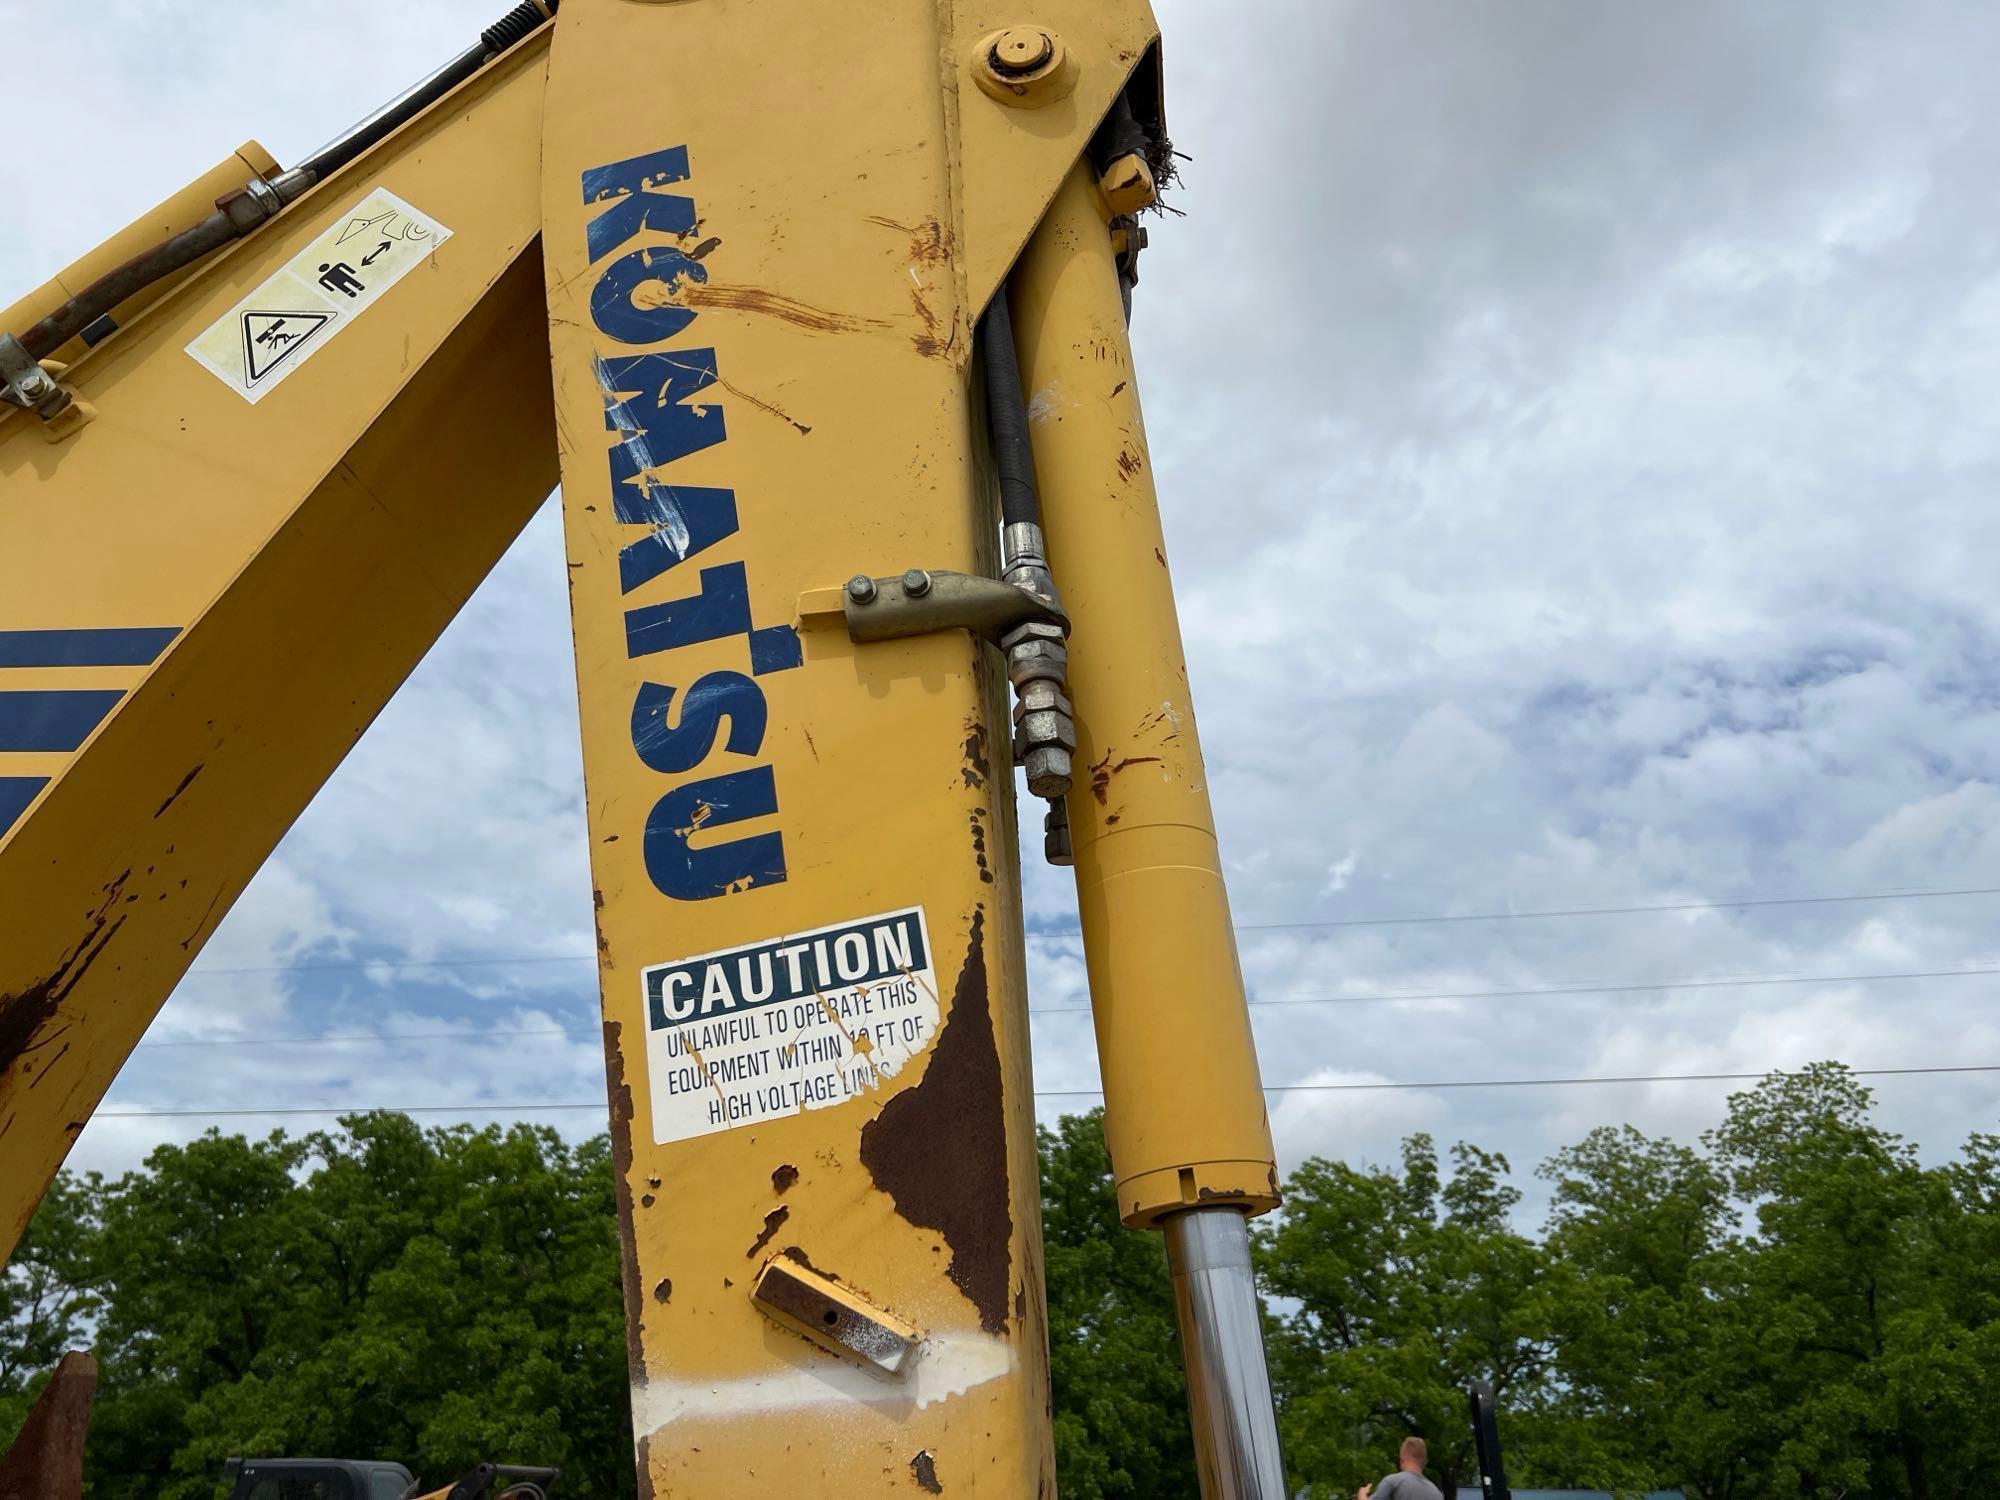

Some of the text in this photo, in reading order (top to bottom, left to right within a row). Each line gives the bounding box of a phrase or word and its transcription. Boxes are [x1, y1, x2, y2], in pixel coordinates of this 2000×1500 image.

[581, 144, 803, 901] KOMATSU
[662, 921, 913, 1020] CAUTION
[667, 981, 918, 1058] UNLAWFUL TO OPERATE THIS
[668, 1050, 770, 1095] EQUIPMENT
[776, 1034, 842, 1070] WITHIN
[875, 1021, 896, 1048] FT
[902, 1015, 924, 1042] OF
[709, 1092, 752, 1125] HIGH
[757, 1074, 837, 1113] VOLTAGE
